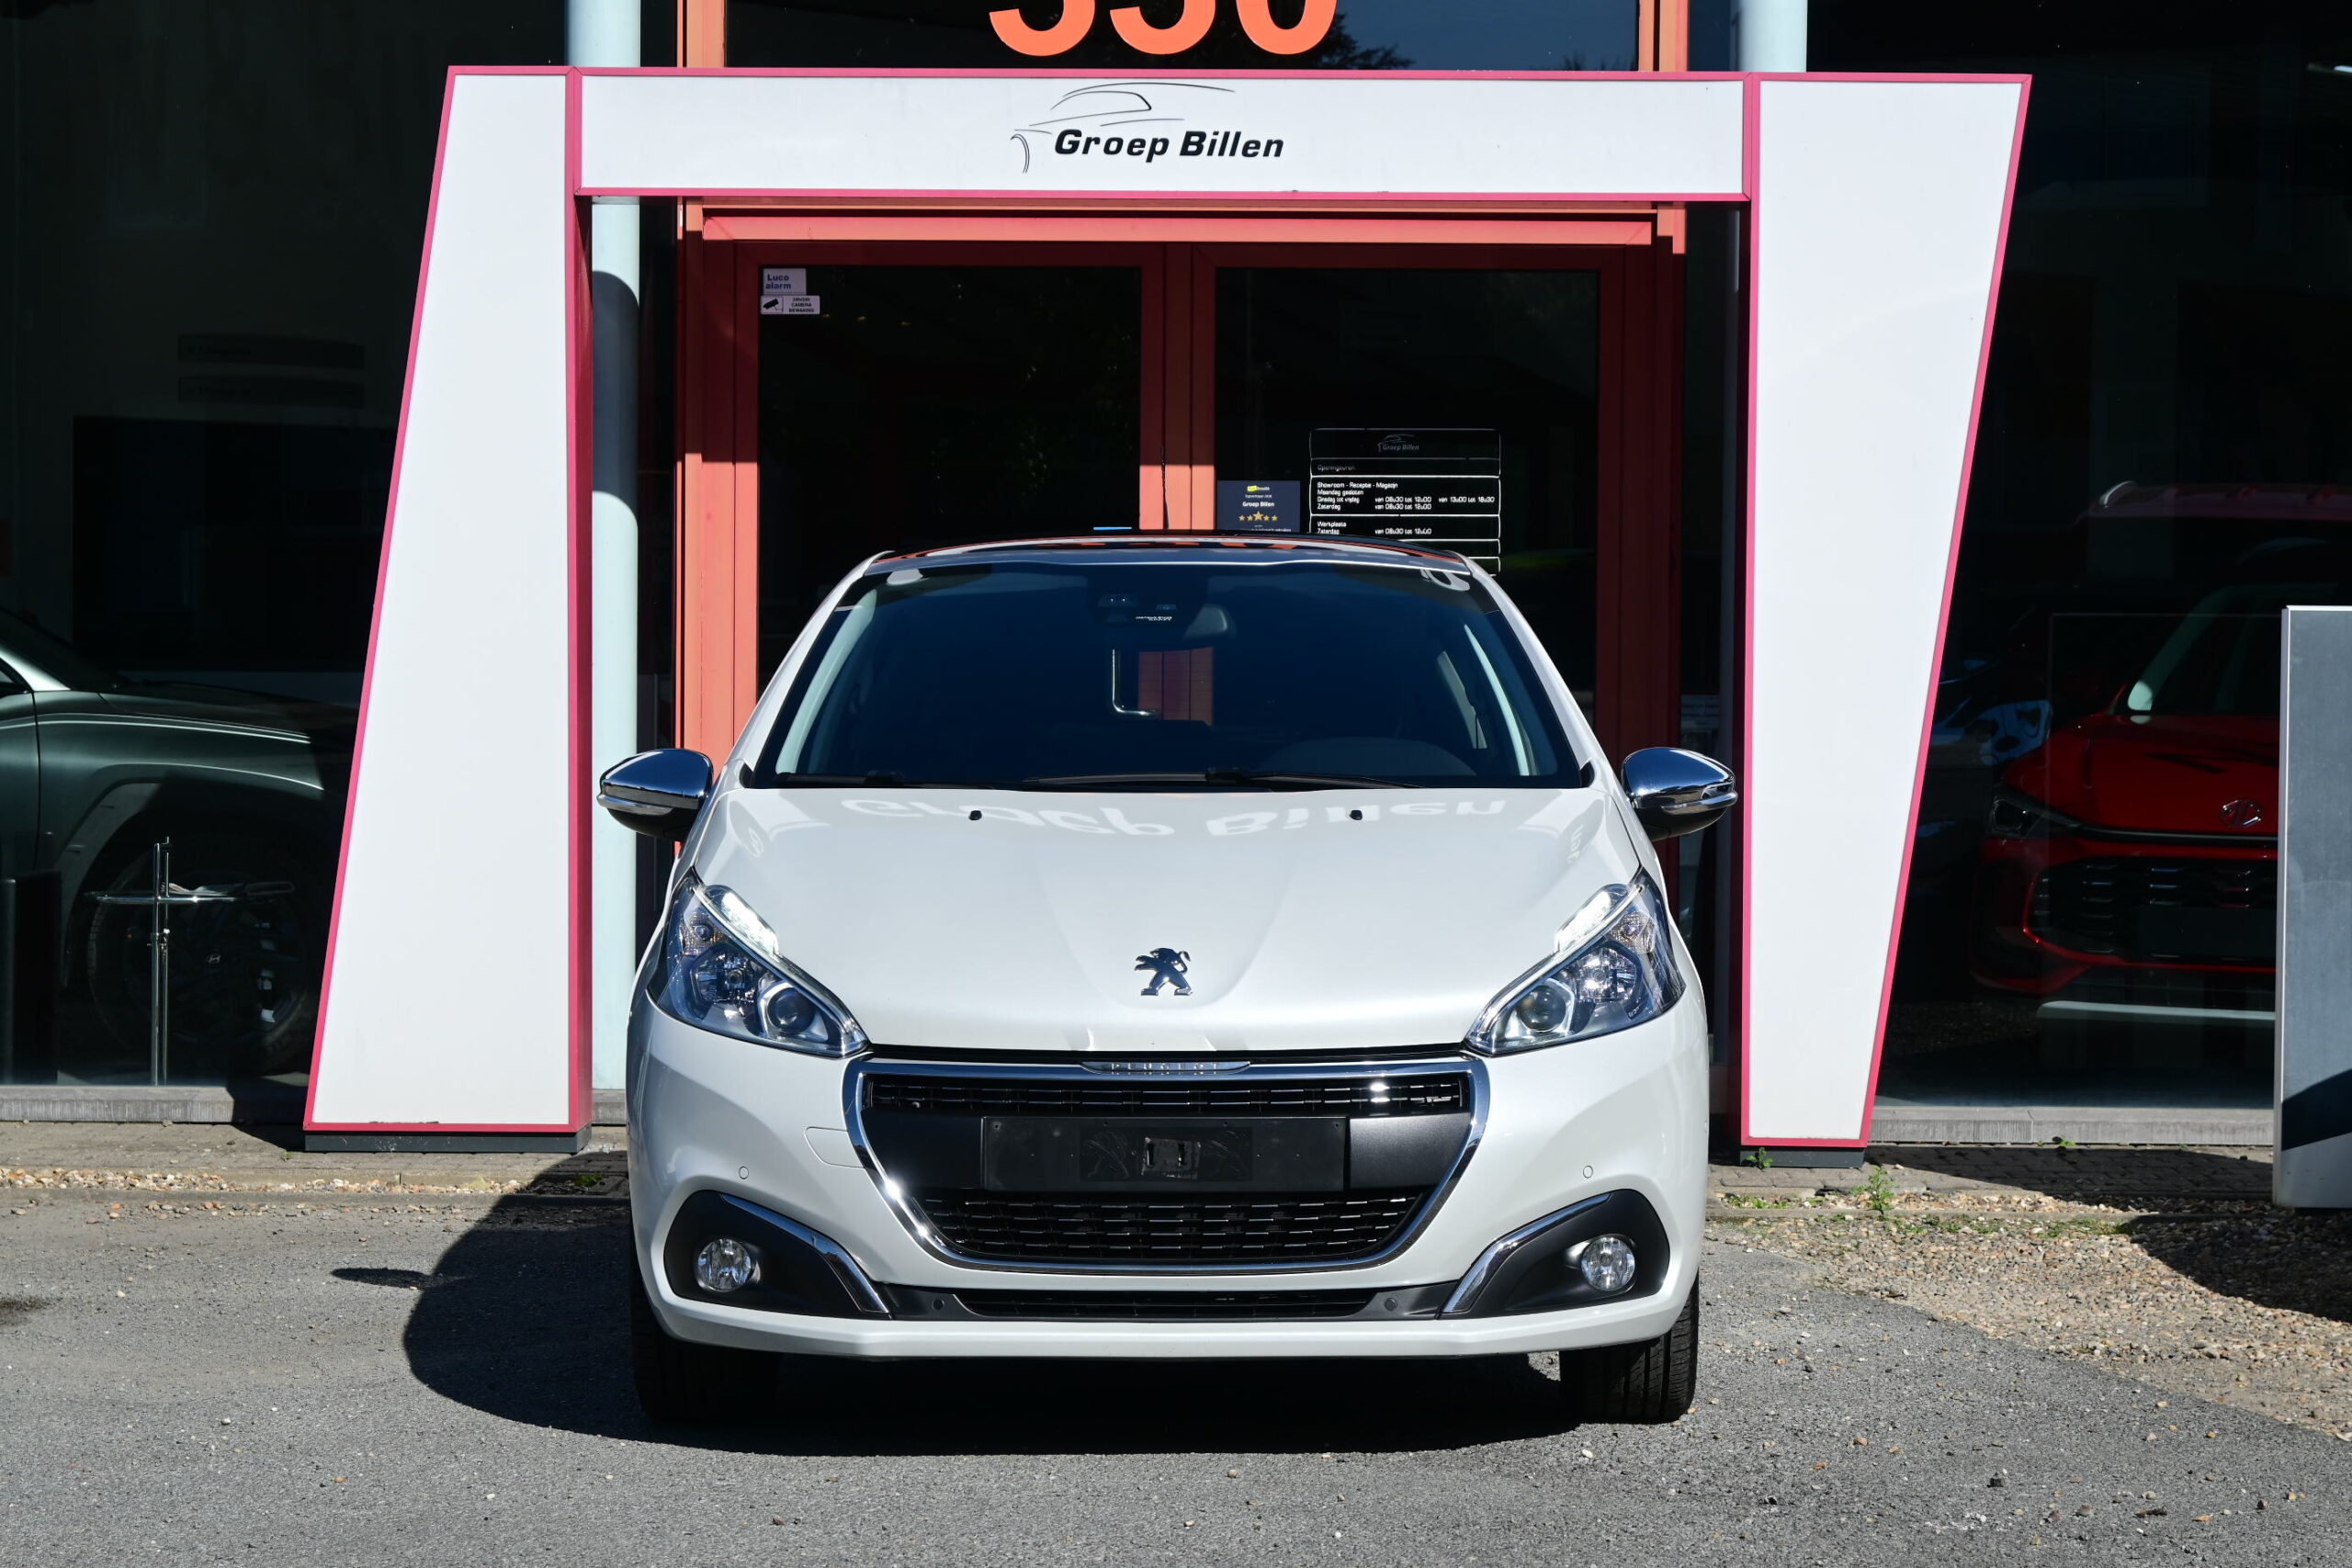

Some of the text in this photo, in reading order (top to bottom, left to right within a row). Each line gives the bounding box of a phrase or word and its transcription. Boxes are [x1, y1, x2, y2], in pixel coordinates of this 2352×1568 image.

[1054, 129, 1284, 163] Groep Billen
[1349, 481, 1373, 490] Receptie
[1317, 489, 1364, 497] Maandag gesloten
